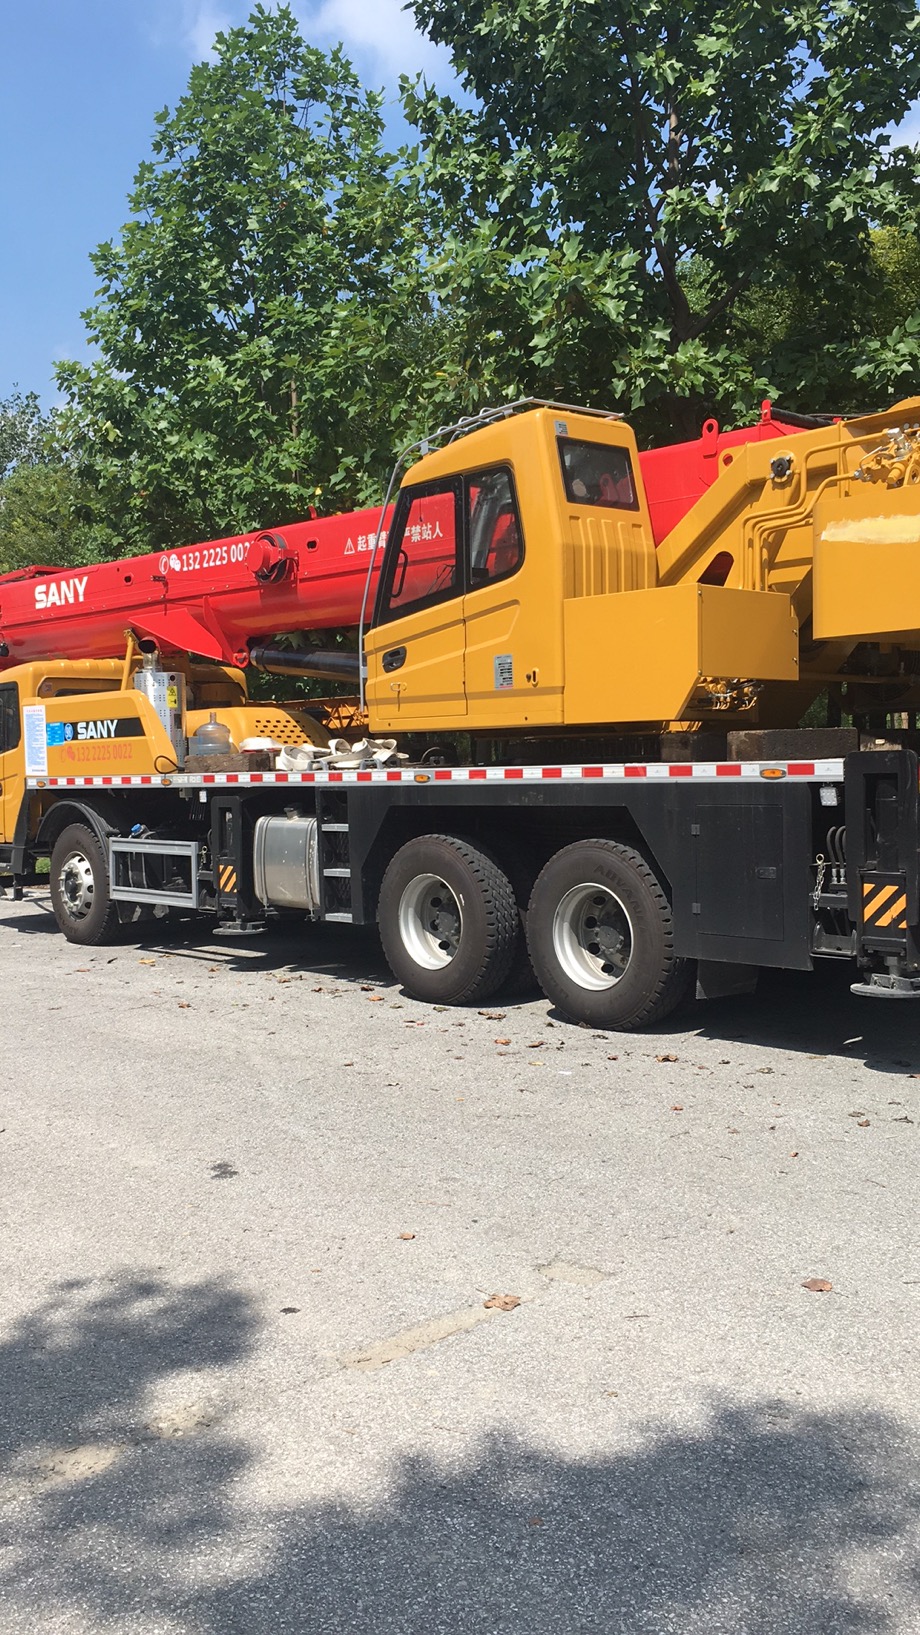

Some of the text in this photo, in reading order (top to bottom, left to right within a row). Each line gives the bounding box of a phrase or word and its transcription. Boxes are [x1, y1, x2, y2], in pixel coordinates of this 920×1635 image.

[182, 541, 254, 572] 132 2225 002
[34, 576, 88, 610] SANY
[77, 720, 118, 740] SANY
[77, 743, 133, 762] 132 2225 0022
